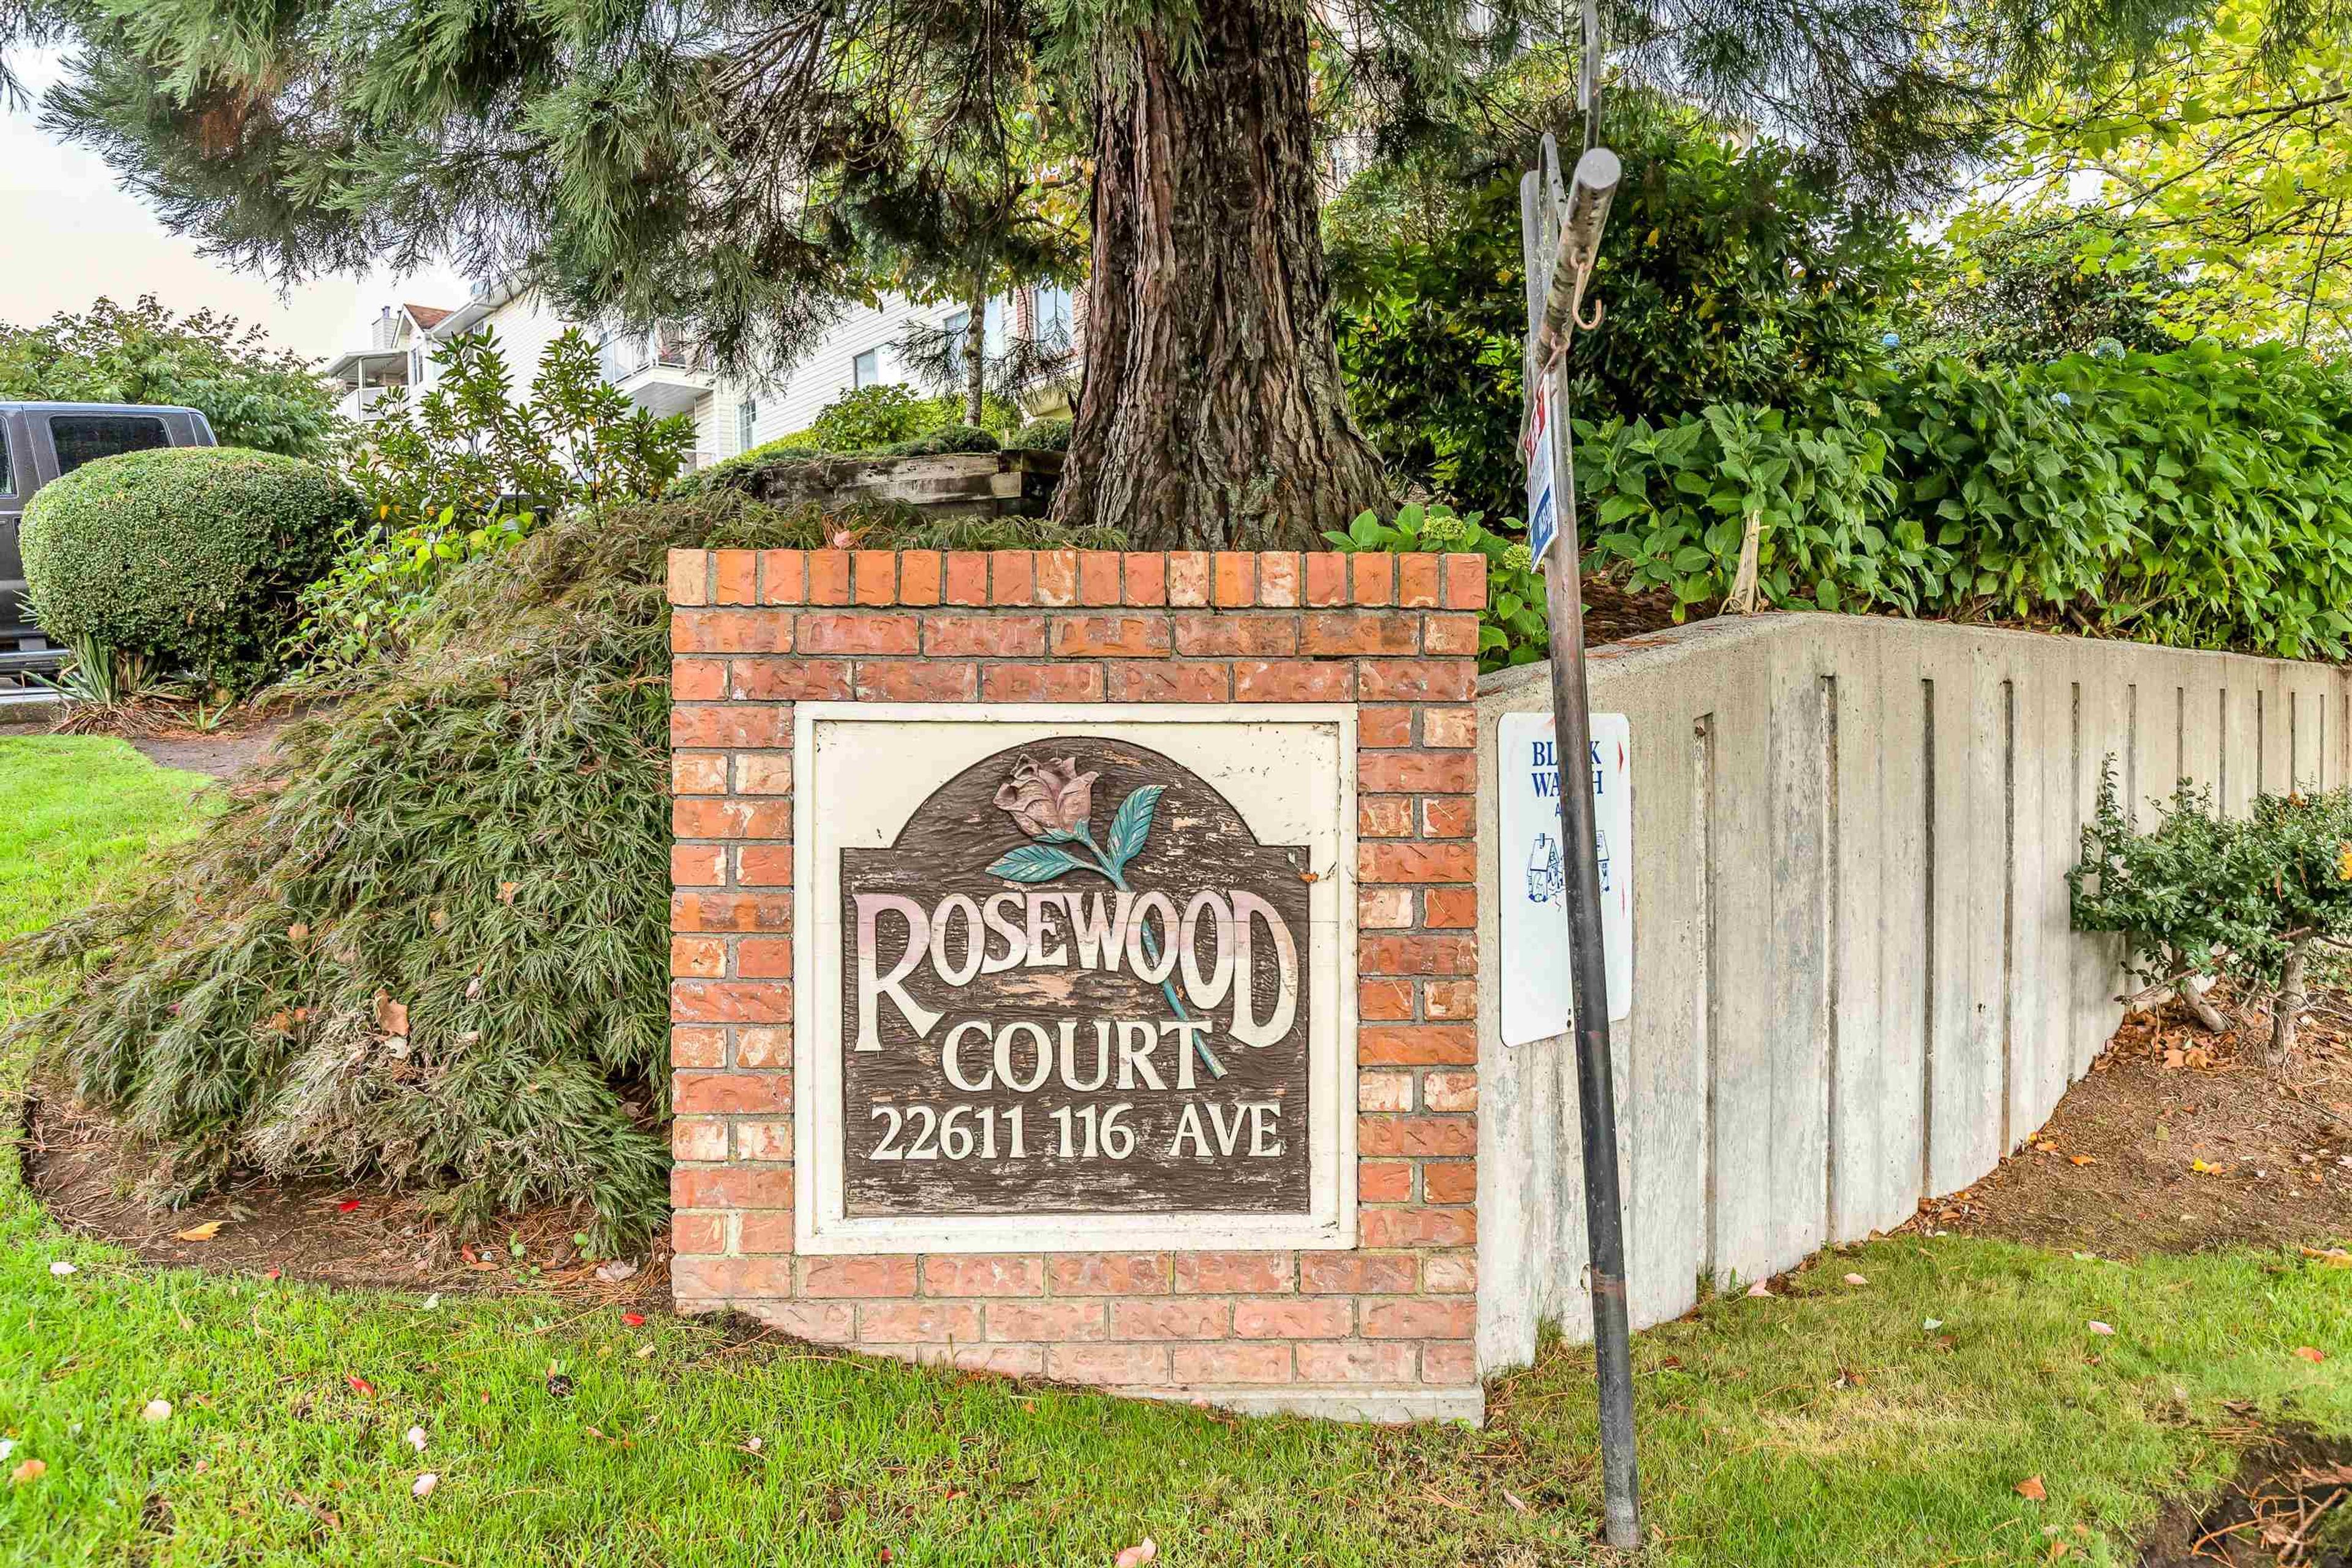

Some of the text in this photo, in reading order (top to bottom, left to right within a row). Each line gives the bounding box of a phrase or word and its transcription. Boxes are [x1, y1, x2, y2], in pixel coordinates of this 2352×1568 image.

[1532, 741, 1601, 766] BLK
[1531, 771, 1603, 797] WAH
[853, 889, 1298, 1051] ROSEWOOD
[942, 1020, 1213, 1092] COURT
[870, 1103, 1283, 1160] 22611 116 AVE
